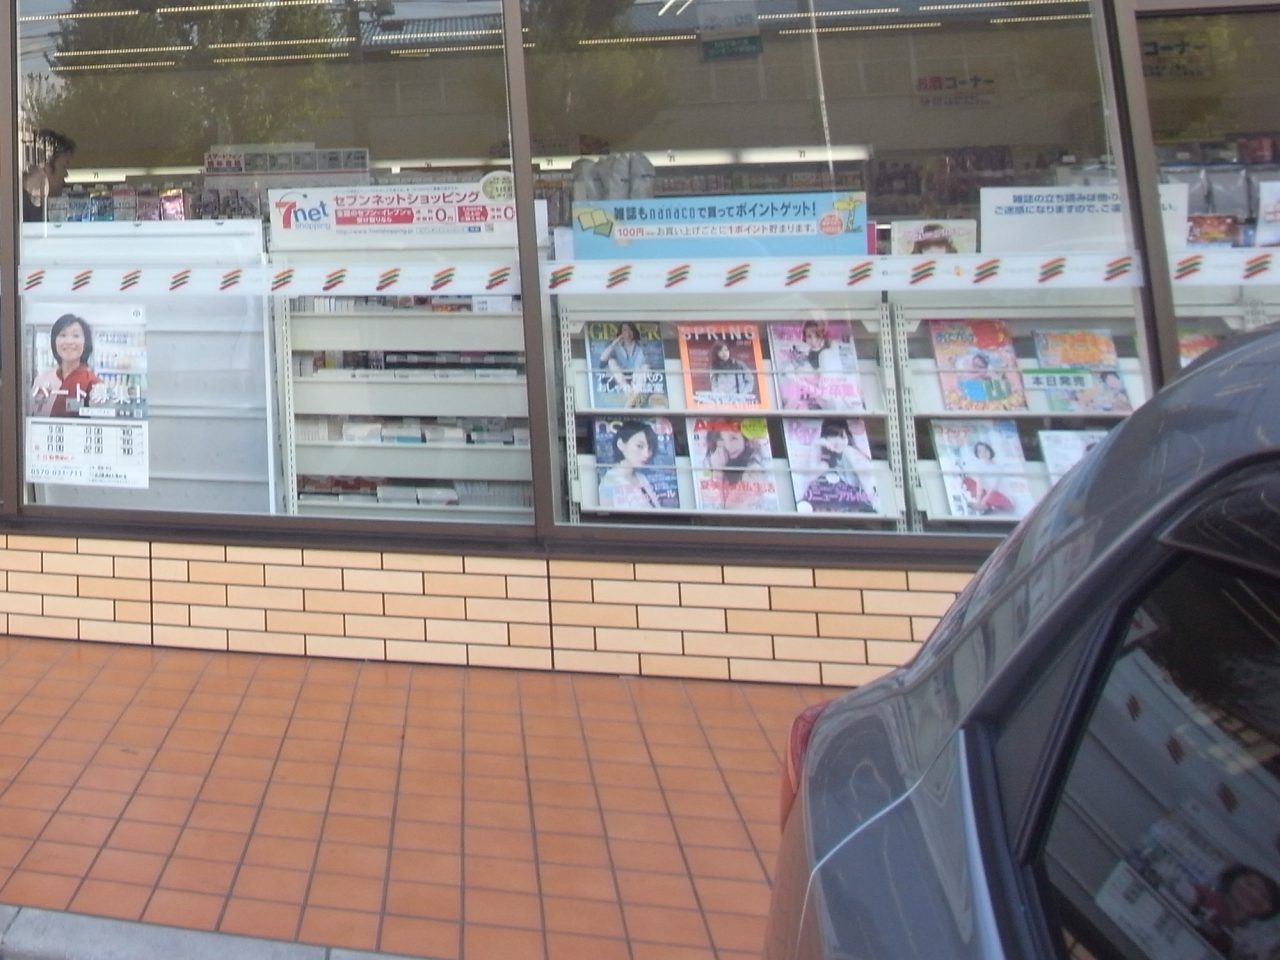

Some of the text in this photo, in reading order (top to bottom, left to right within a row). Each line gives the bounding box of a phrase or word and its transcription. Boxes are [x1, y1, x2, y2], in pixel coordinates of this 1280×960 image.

[334, 191, 480, 208] セブンネットショッピング
[681, 326, 754, 341] SPRING
[1032, 376, 1085, 387] 本日発売
